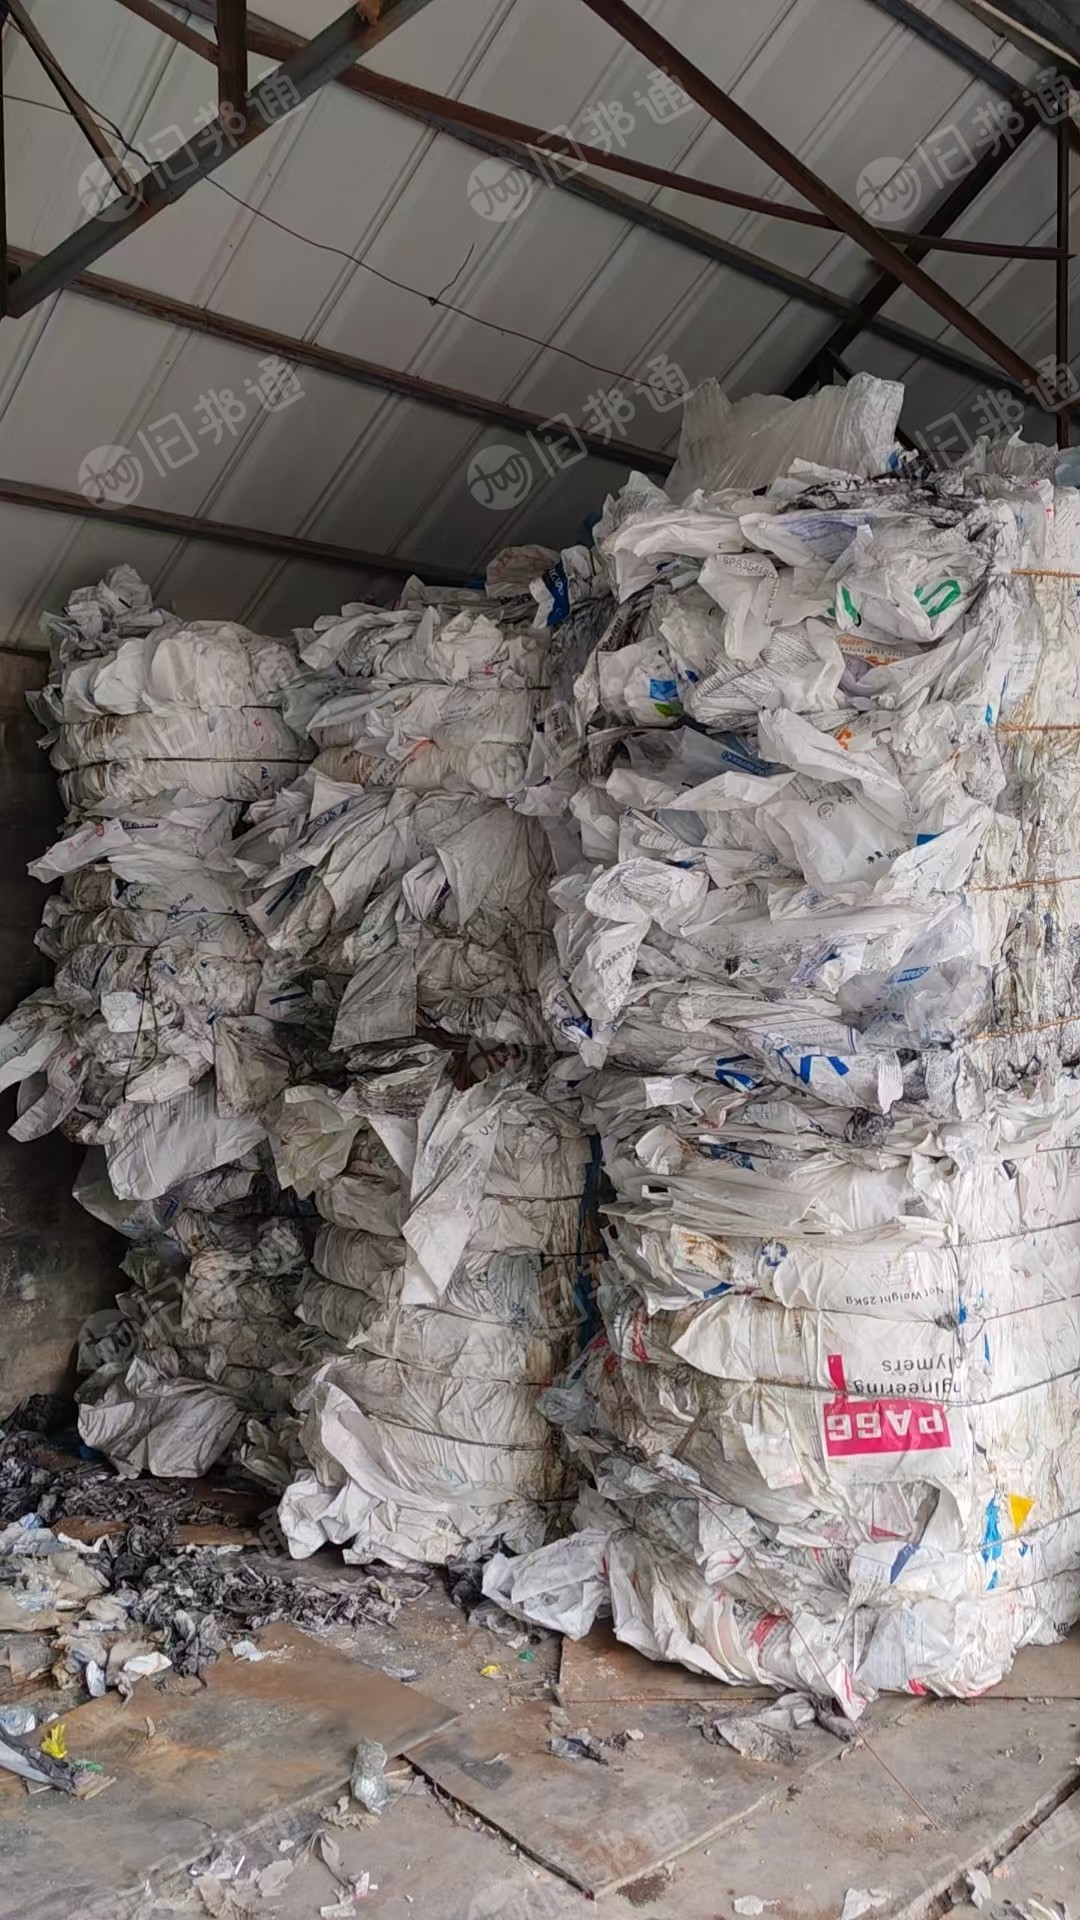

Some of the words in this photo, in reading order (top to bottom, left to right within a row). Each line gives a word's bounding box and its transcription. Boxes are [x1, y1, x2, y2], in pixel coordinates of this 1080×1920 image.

[845, 1294, 877, 1305] 25Kg
[879, 1290, 922, 1304] Weight
[923, 1285, 944, 1298] Net
[881, 1353, 962, 1374] olymers
[853, 1379, 961, 1397] ngineering
[826, 1408, 944, 1441] PA66
